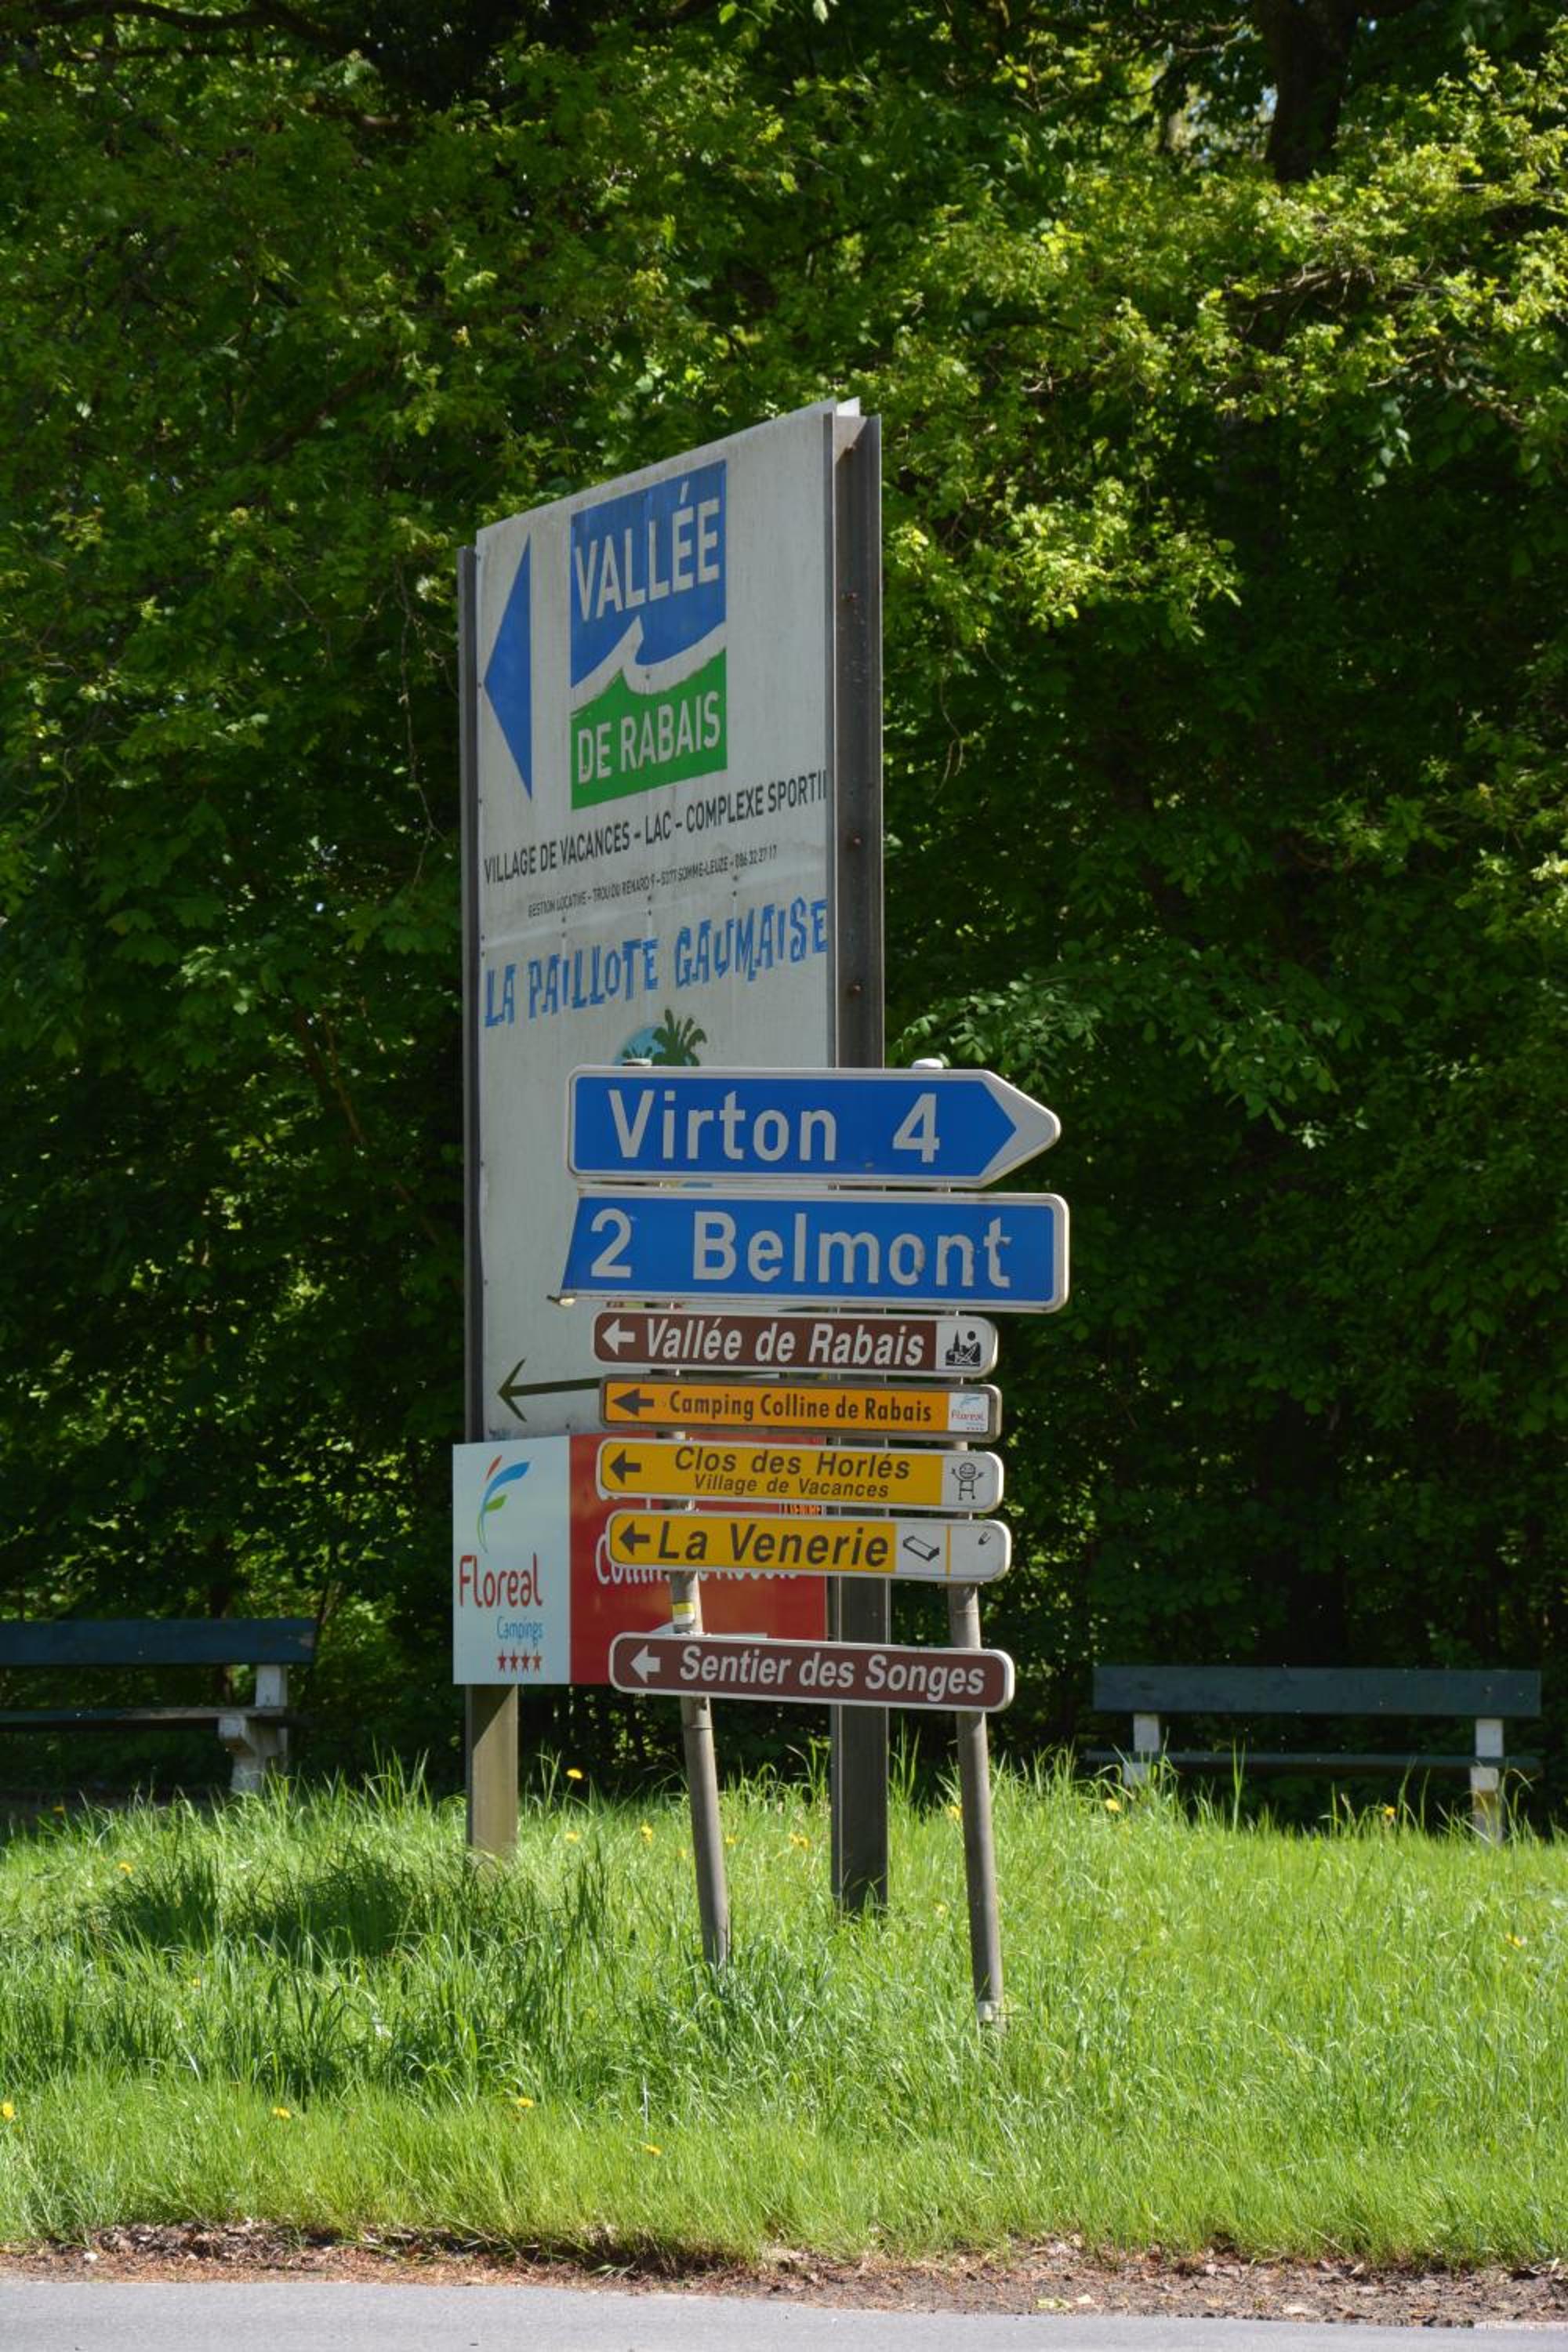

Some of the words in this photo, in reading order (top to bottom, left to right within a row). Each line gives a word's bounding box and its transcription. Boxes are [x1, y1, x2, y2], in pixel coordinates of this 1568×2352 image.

[576, 481, 719, 622] VALLÉE
[577, 722, 612, 784] DE
[620, 691, 720, 772] RABAIS
[485, 845, 536, 884] VILLAGE
[540, 841, 557, 873] DE
[560, 822, 630, 866] VACANCES
[645, 811, 672, 844] LAC
[686, 786, 764, 833] COMPLEXE
[485, 964, 517, 1027] LA
[528, 938, 658, 1019] PAILLOTE
[675, 896, 828, 989] GAUMAISE
[608, 1090, 837, 1161] Virton
[891, 1093, 939, 1163] 4
[590, 1208, 631, 1278] 2
[693, 1211, 1011, 1288] Belmont
[647, 1317, 742, 1360] Vallée
[755, 1322, 796, 1363] de
[808, 1323, 924, 1367] Rabais
[670, 1390, 753, 1421] Camping
[761, 1394, 827, 1417] Colline
[836, 1396, 858, 1418] de
[866, 1397, 931, 1421] Rabais
[675, 1446, 736, 1472] Clos
[752, 1450, 801, 1474] des
[817, 1452, 911, 1479] Horlés
[695, 1473, 757, 1494] Village
[766, 1477, 789, 1494] de
[798, 1478, 889, 1498] Vacances
[658, 1521, 707, 1561] La
[730, 1523, 889, 1568] Venerie
[459, 1552, 543, 1607] Floreal
[496, 1616, 543, 1647] Campings
[680, 1646, 789, 1685] Sentier
[799, 1652, 855, 1688] des
[865, 1654, 985, 1702] Songes
